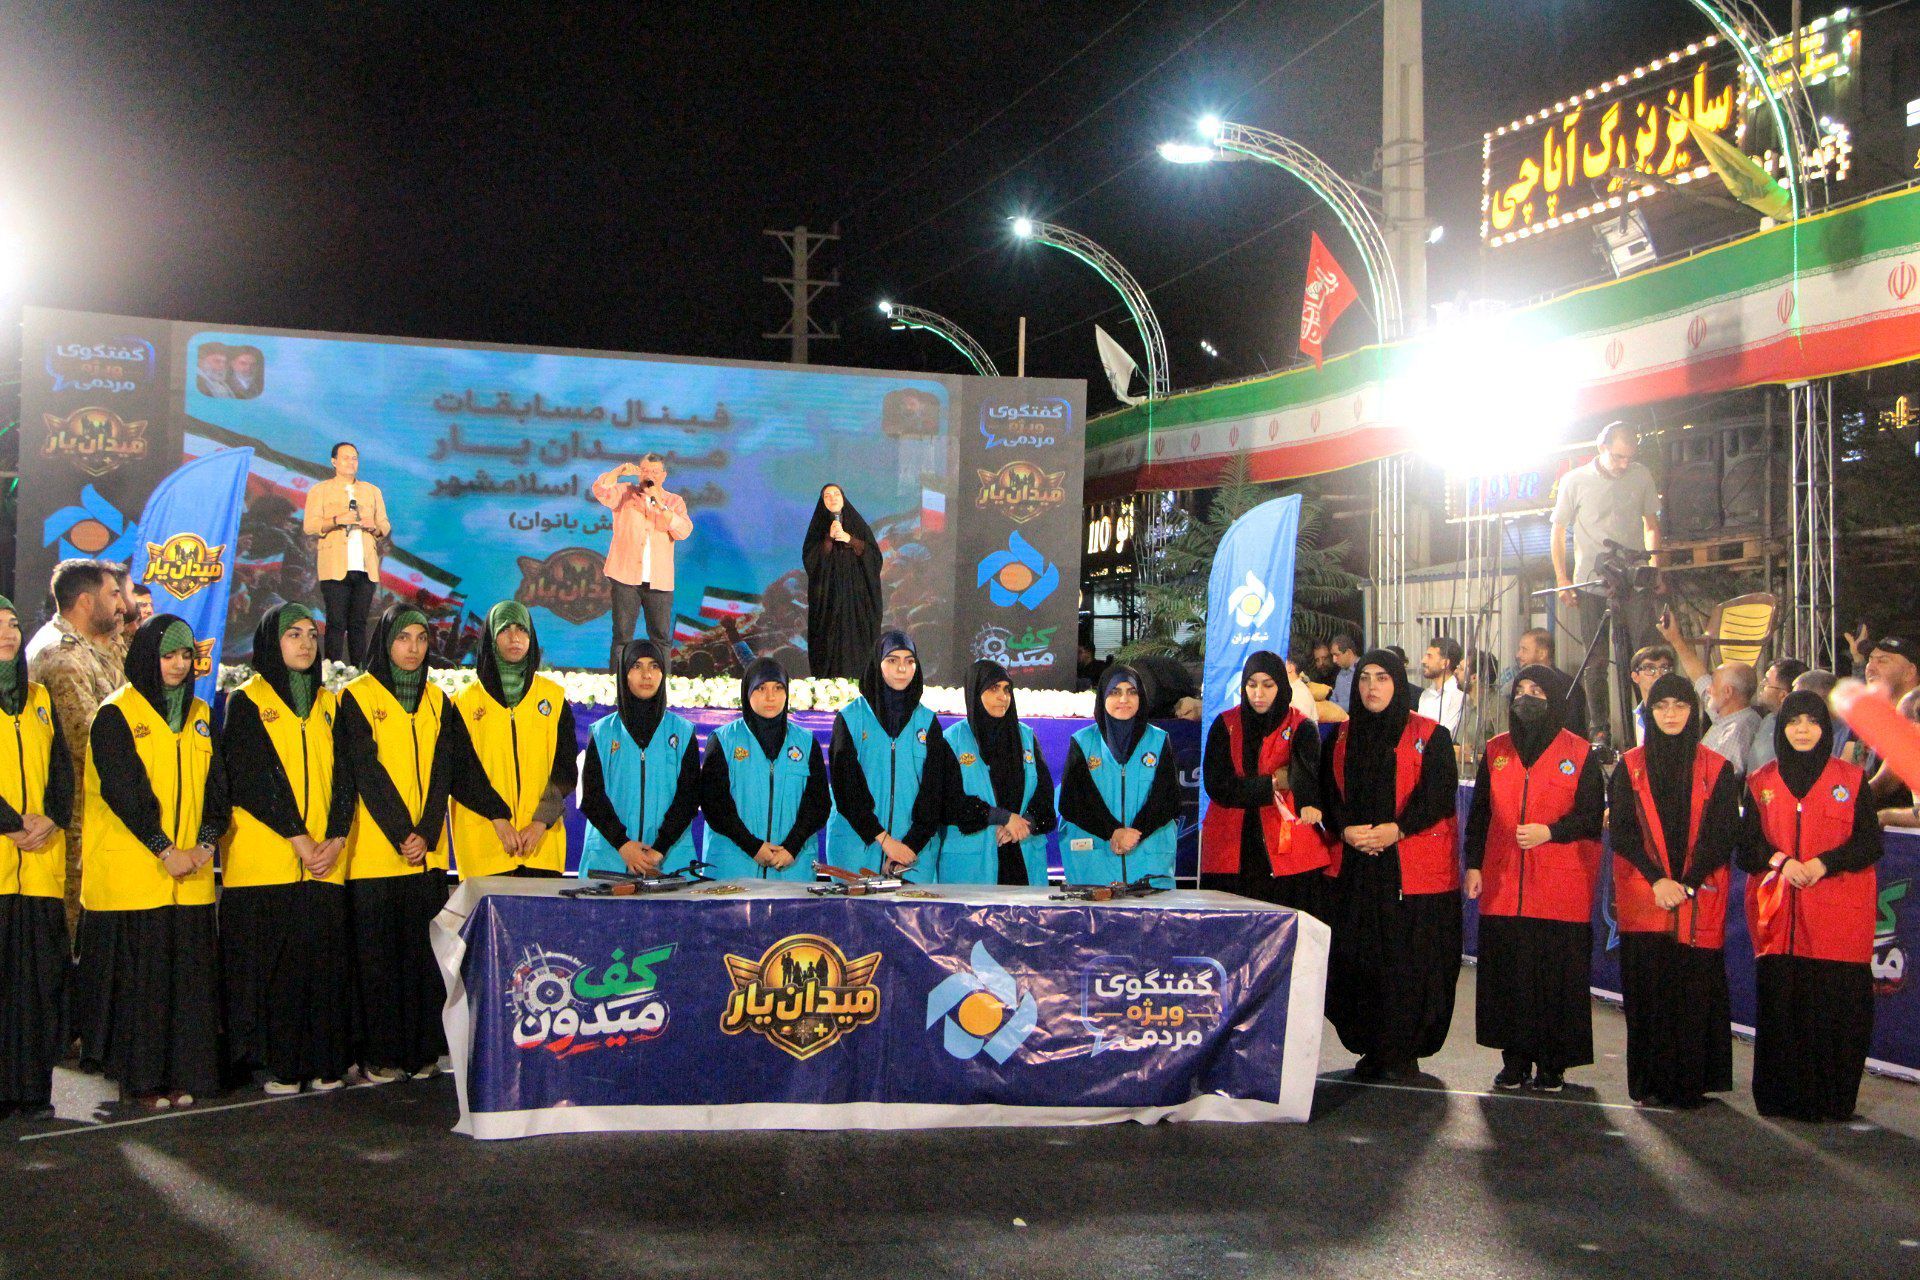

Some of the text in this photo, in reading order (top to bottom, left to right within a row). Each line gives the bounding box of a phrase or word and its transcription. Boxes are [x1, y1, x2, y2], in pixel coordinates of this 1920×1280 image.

[1491, 105, 1583, 230] آپاچی
[433, 389, 730, 434] فینال مسابقات
[145, 556, 222, 583] میدان یار
[573, 944, 676, 999] کف
[1094, 967, 1214, 1001] گفتگوی
[726, 980, 876, 1026] میدان یار
[1125, 998, 1185, 1027] ویژه
[1118, 1028, 1204, 1052] مردمی
